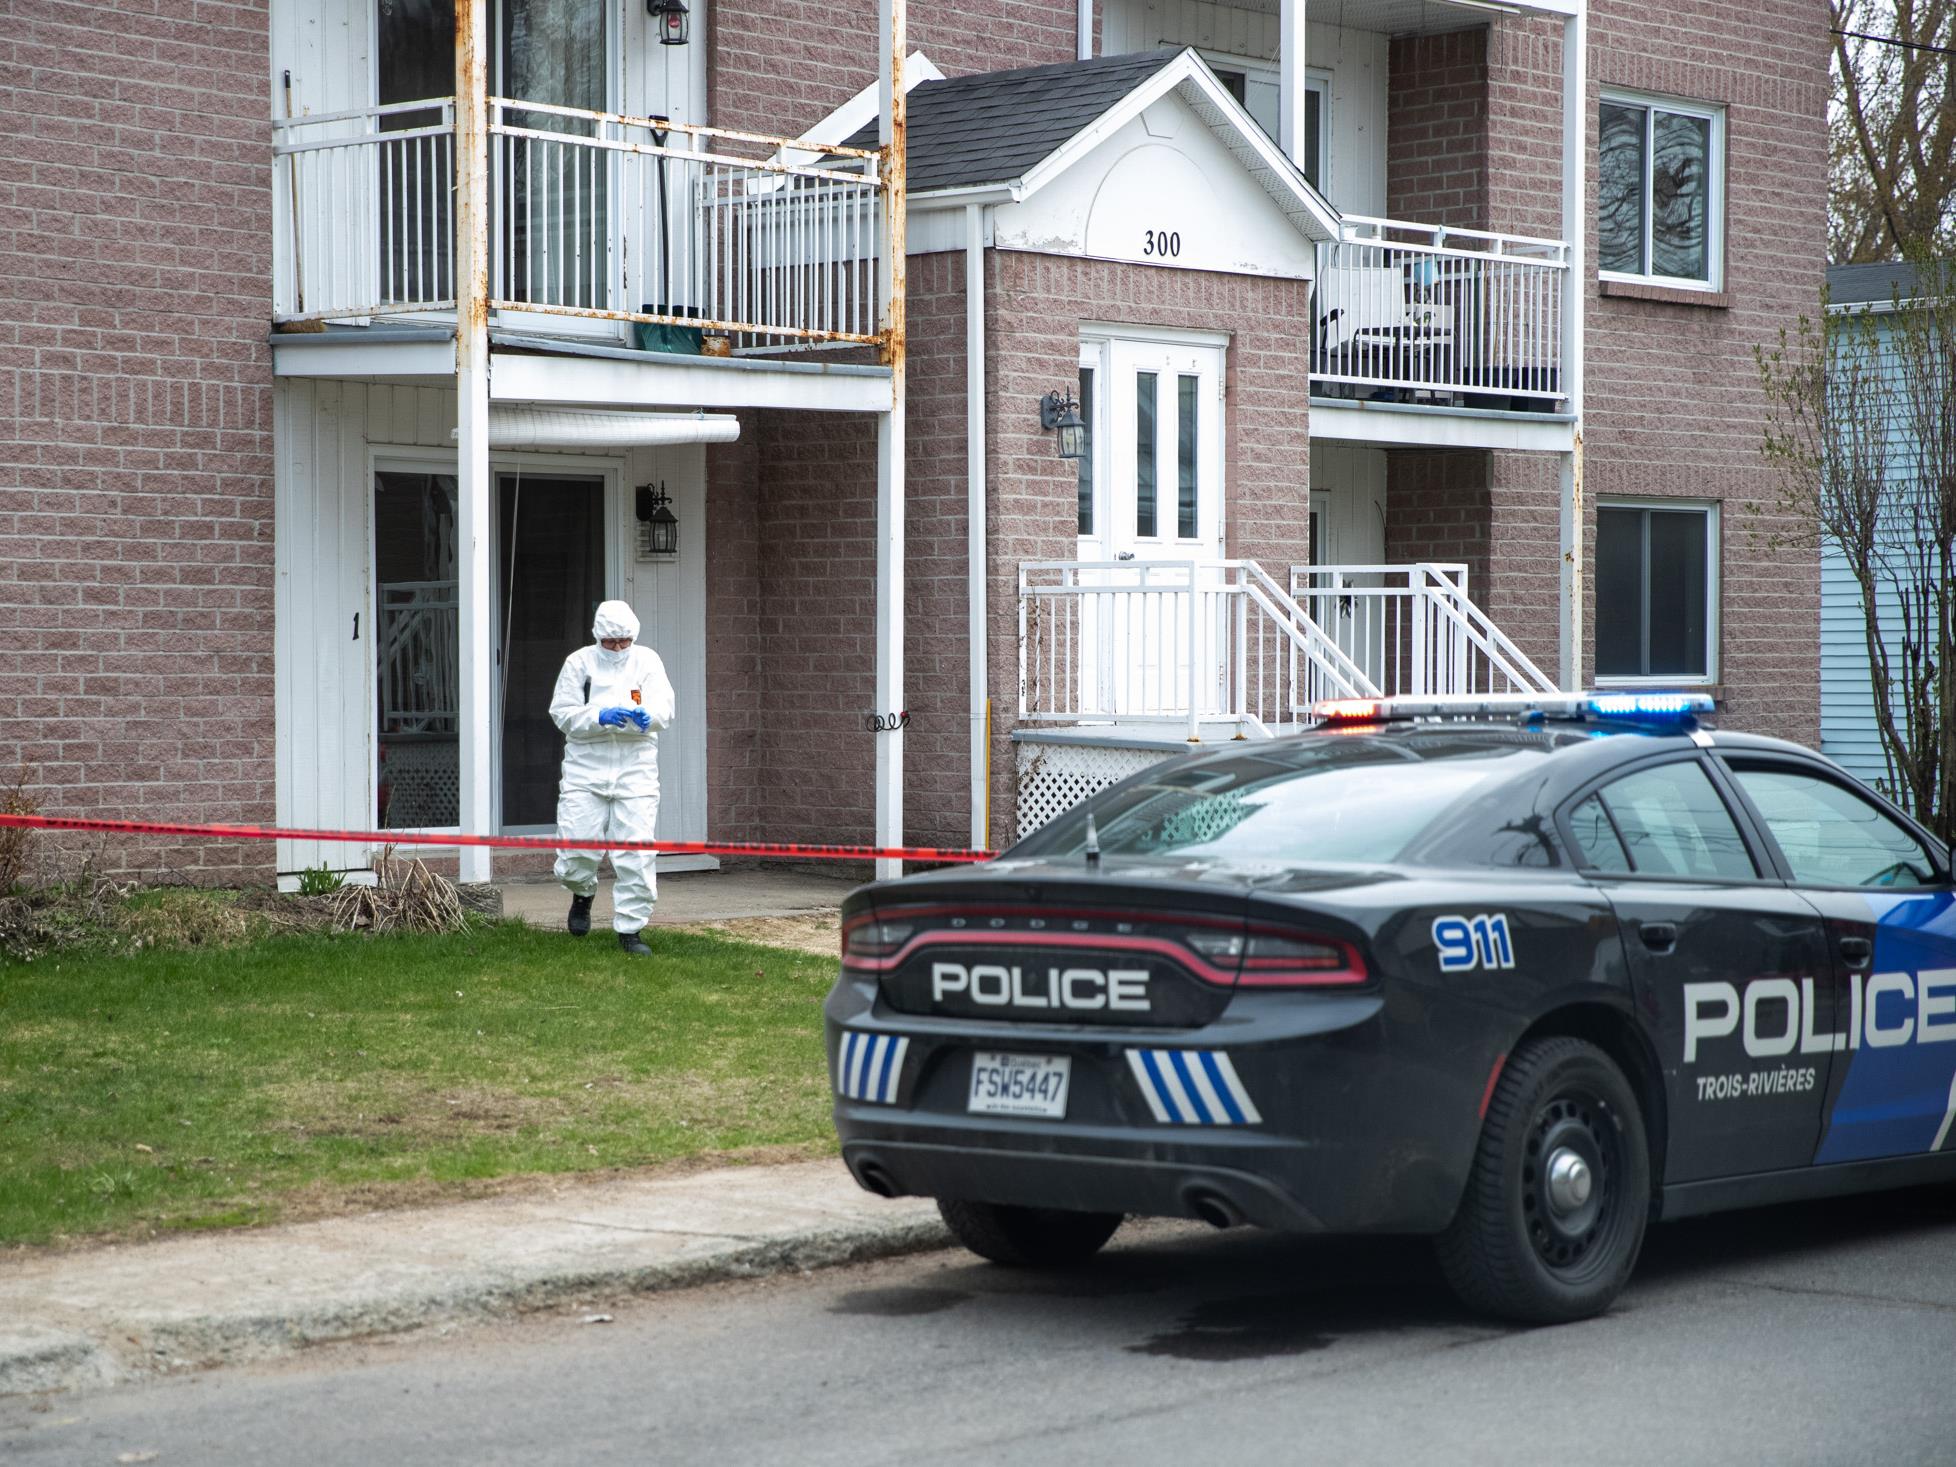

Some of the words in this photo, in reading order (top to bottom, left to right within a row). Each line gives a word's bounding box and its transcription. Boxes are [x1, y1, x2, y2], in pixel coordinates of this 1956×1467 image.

[1143, 229, 1181, 257] 300
[352, 611, 360, 641] 1
[1432, 914, 1515, 972] 911
[932, 962, 1151, 1010] POLICE
[1683, 968, 1956, 1063] POLICE
[974, 1067, 1065, 1102] FSW5447
[1697, 1065, 1816, 1100] TROIS-RIVIÈRES
